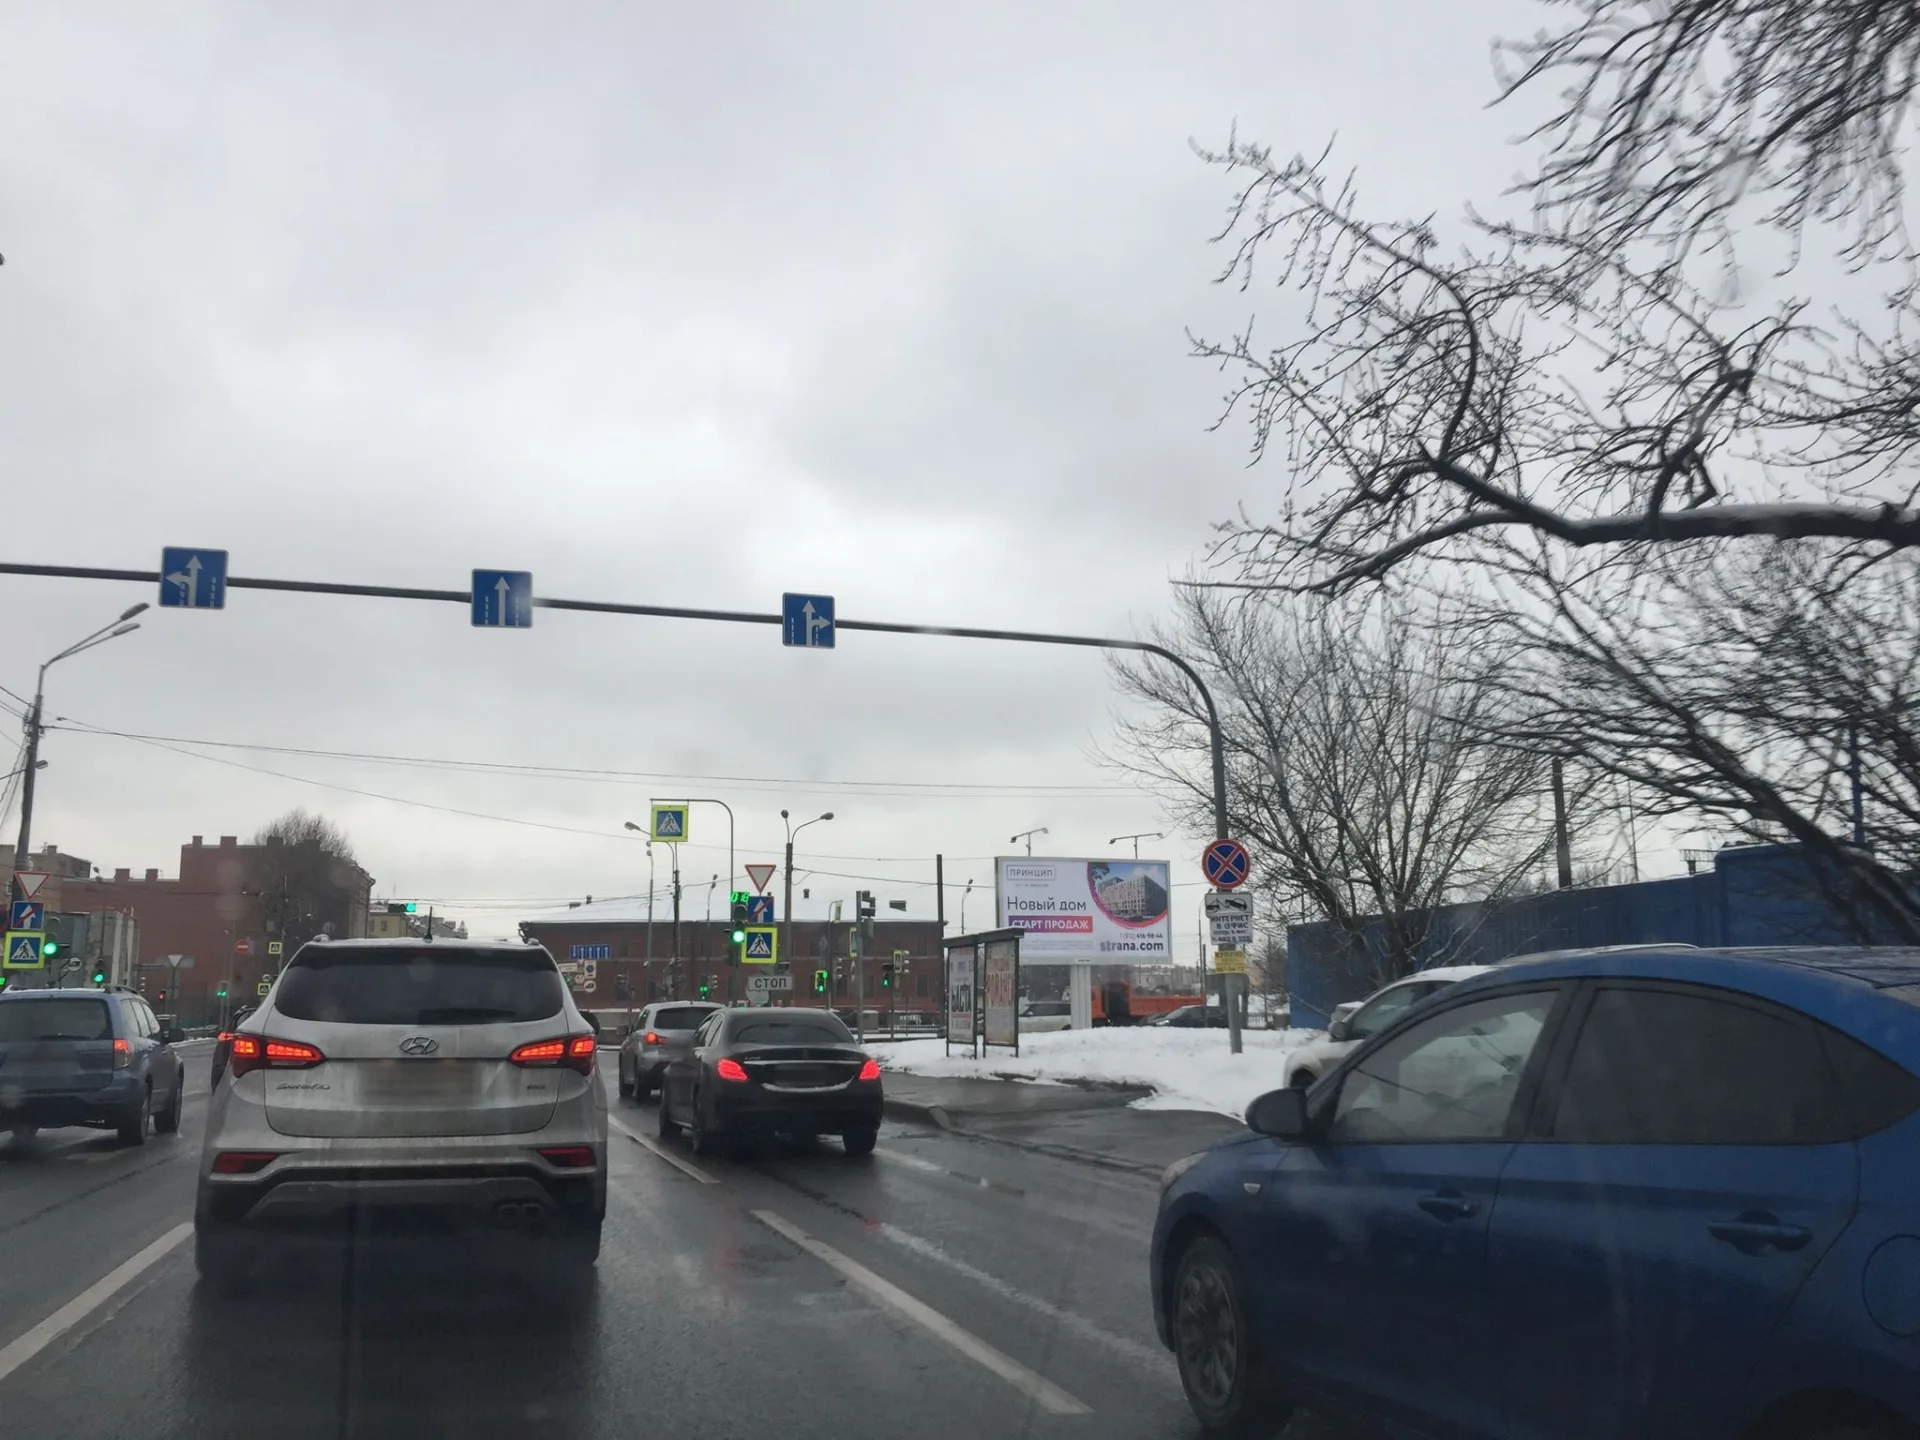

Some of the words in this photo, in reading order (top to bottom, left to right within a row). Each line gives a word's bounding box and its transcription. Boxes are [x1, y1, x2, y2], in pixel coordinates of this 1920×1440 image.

[1009, 869, 1053, 877] ПРИНЦИП
[1007, 896, 1055, 911] Новый
[1059, 901, 1087, 911] дом
[1011, 919, 1043, 930] СТАРТ
[1045, 919, 1089, 930] ПРОДАЖ
[1100, 940, 1164, 952] strana.com
[754, 978, 787, 988] СТОП
